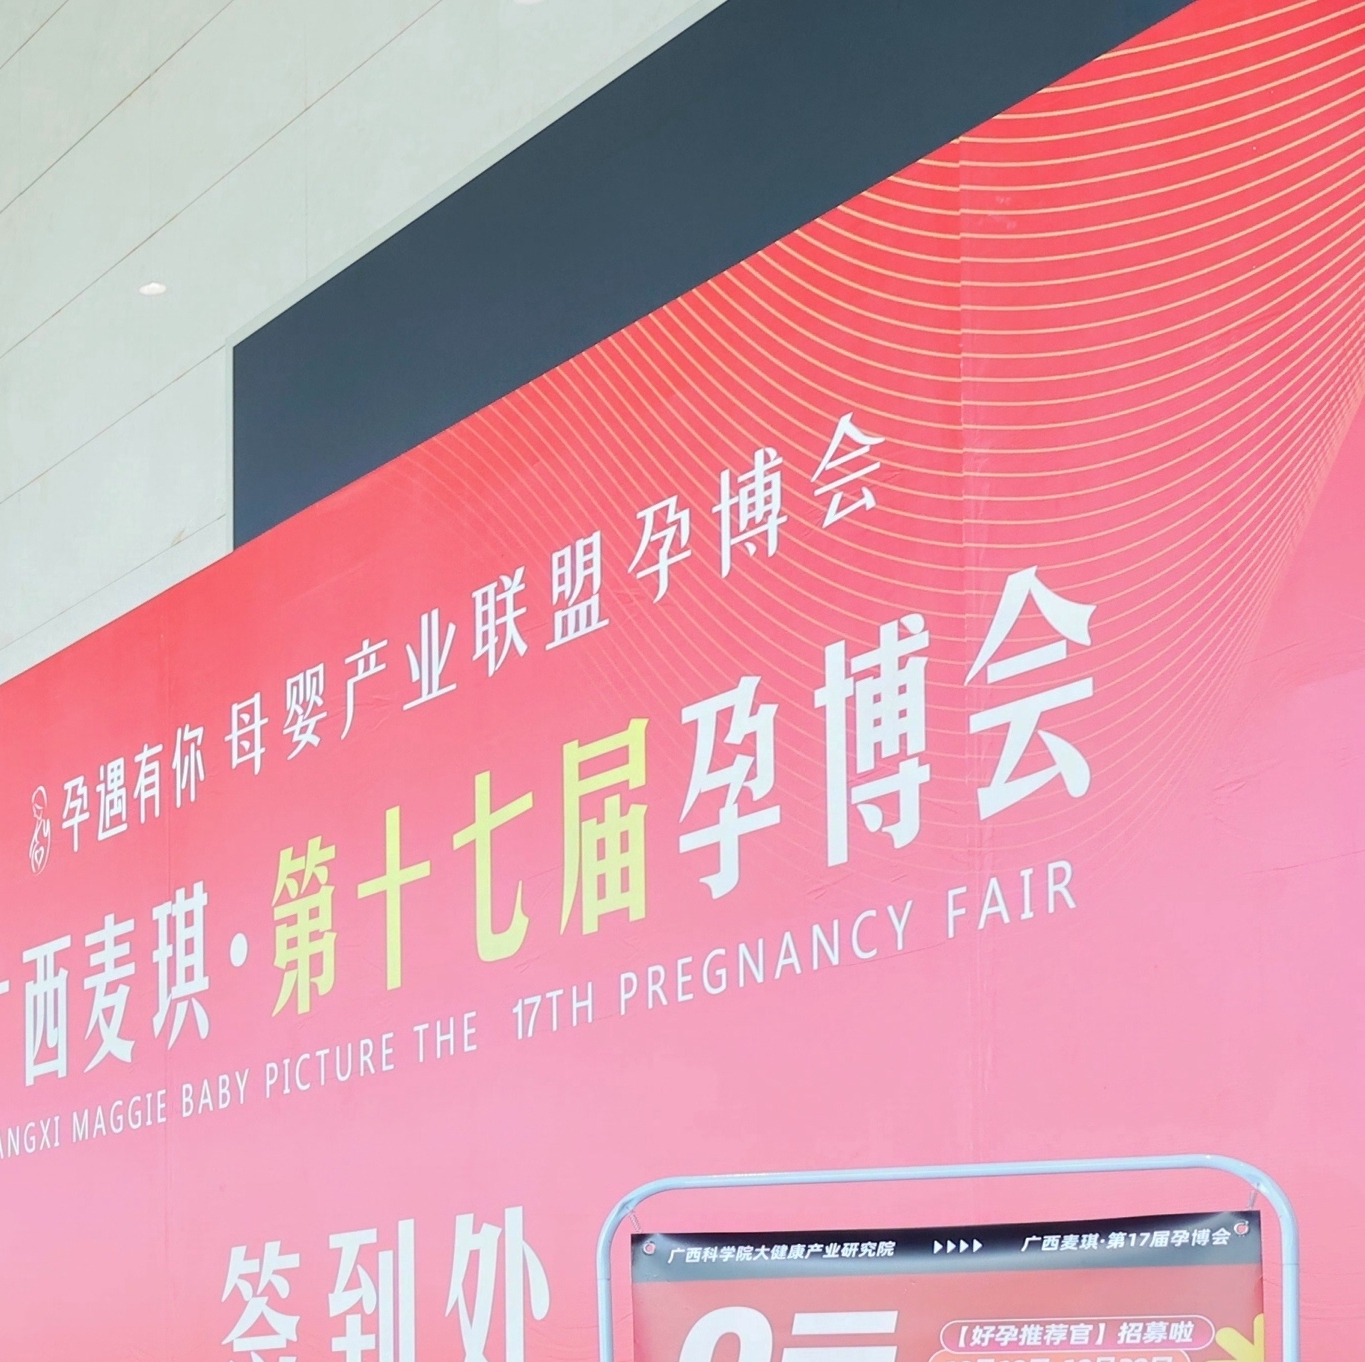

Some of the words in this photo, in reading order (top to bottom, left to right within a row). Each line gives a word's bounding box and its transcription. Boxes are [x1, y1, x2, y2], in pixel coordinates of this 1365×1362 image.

[61, 724, 206, 854] 孕遇有你
[224, 411, 886, 776] 母婴产业联盟孕博会
[72, 1087, 168, 1144] MAGGIE
[181, 1068, 250, 1118] BABY
[265, 1039, 396, 1100] PICTURE
[413, 1012, 478, 1063] THE
[512, 982, 594, 1043] 17TH
[620, 900, 914, 1008] PREGNANCY
[946, 860, 1077, 937] FAIR
[668, 1240, 896, 1264] 广西科学院大健康产业研究院
